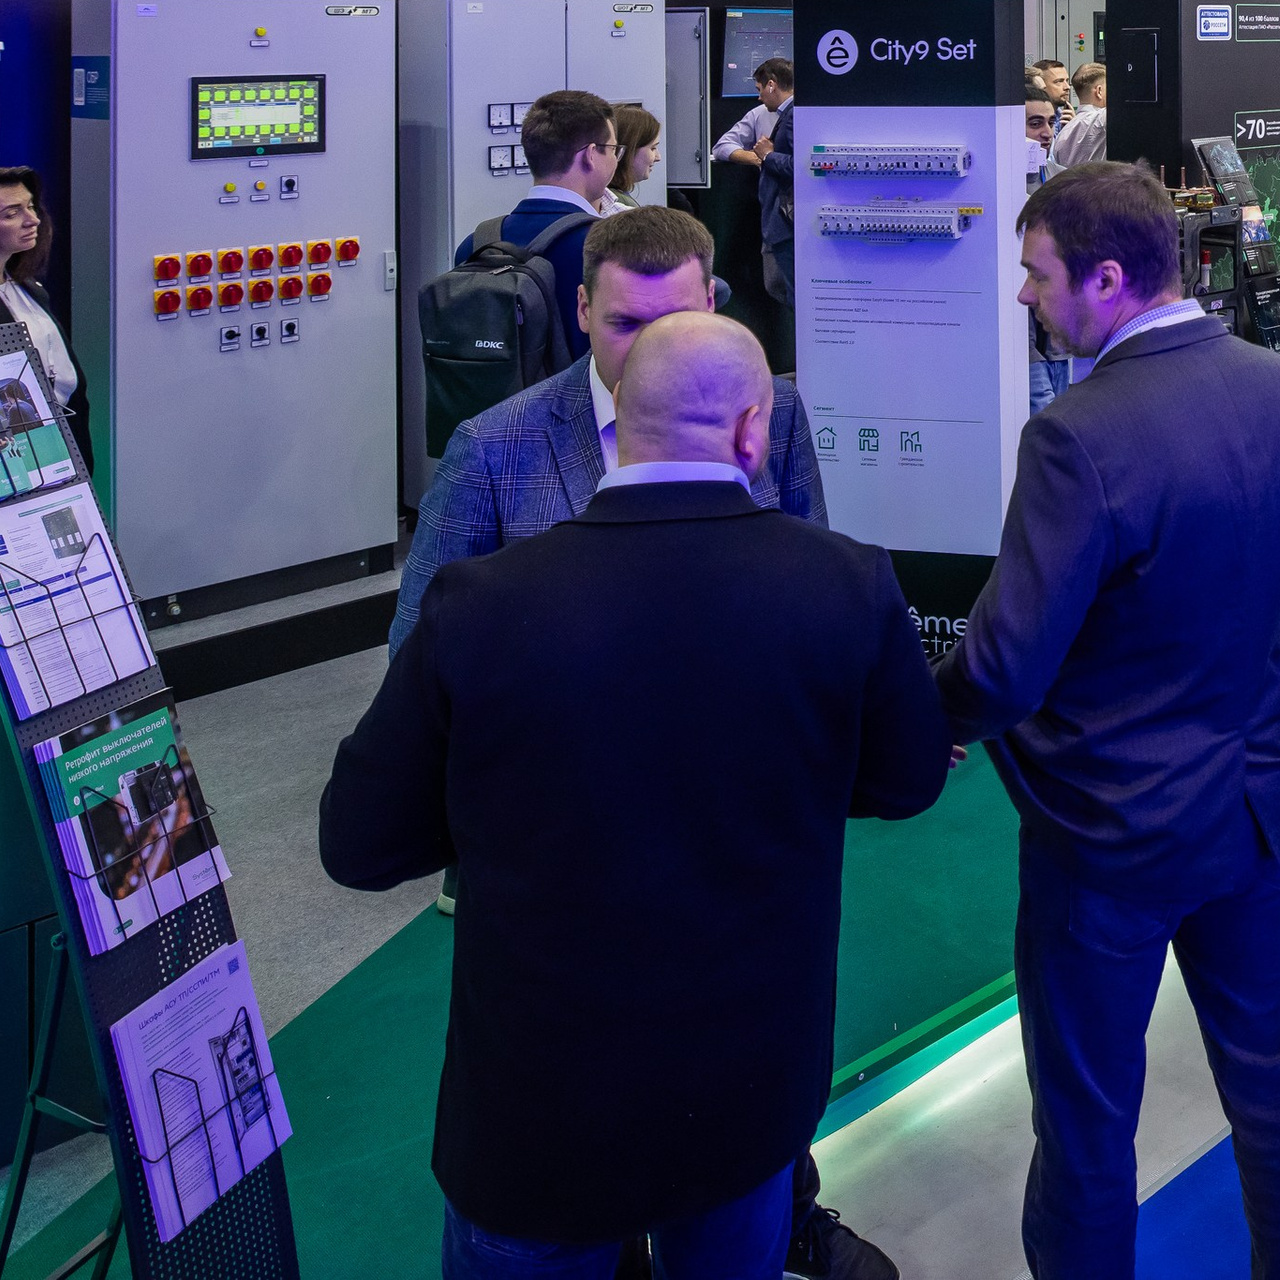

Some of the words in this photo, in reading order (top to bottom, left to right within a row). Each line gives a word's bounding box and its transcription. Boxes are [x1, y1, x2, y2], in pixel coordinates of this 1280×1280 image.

[870, 37, 930, 66] City9
[936, 37, 977, 61] Set
[483, 340, 505, 350] DKC
[65, 747, 101, 771] Ретрофит
[102, 716, 167, 754] выключателей
[68, 763, 99, 784] низкого
[99, 736, 154, 769] напряжения
[138, 1009, 164, 1031] Шкафы
[164, 995, 177, 1012] АСУ
